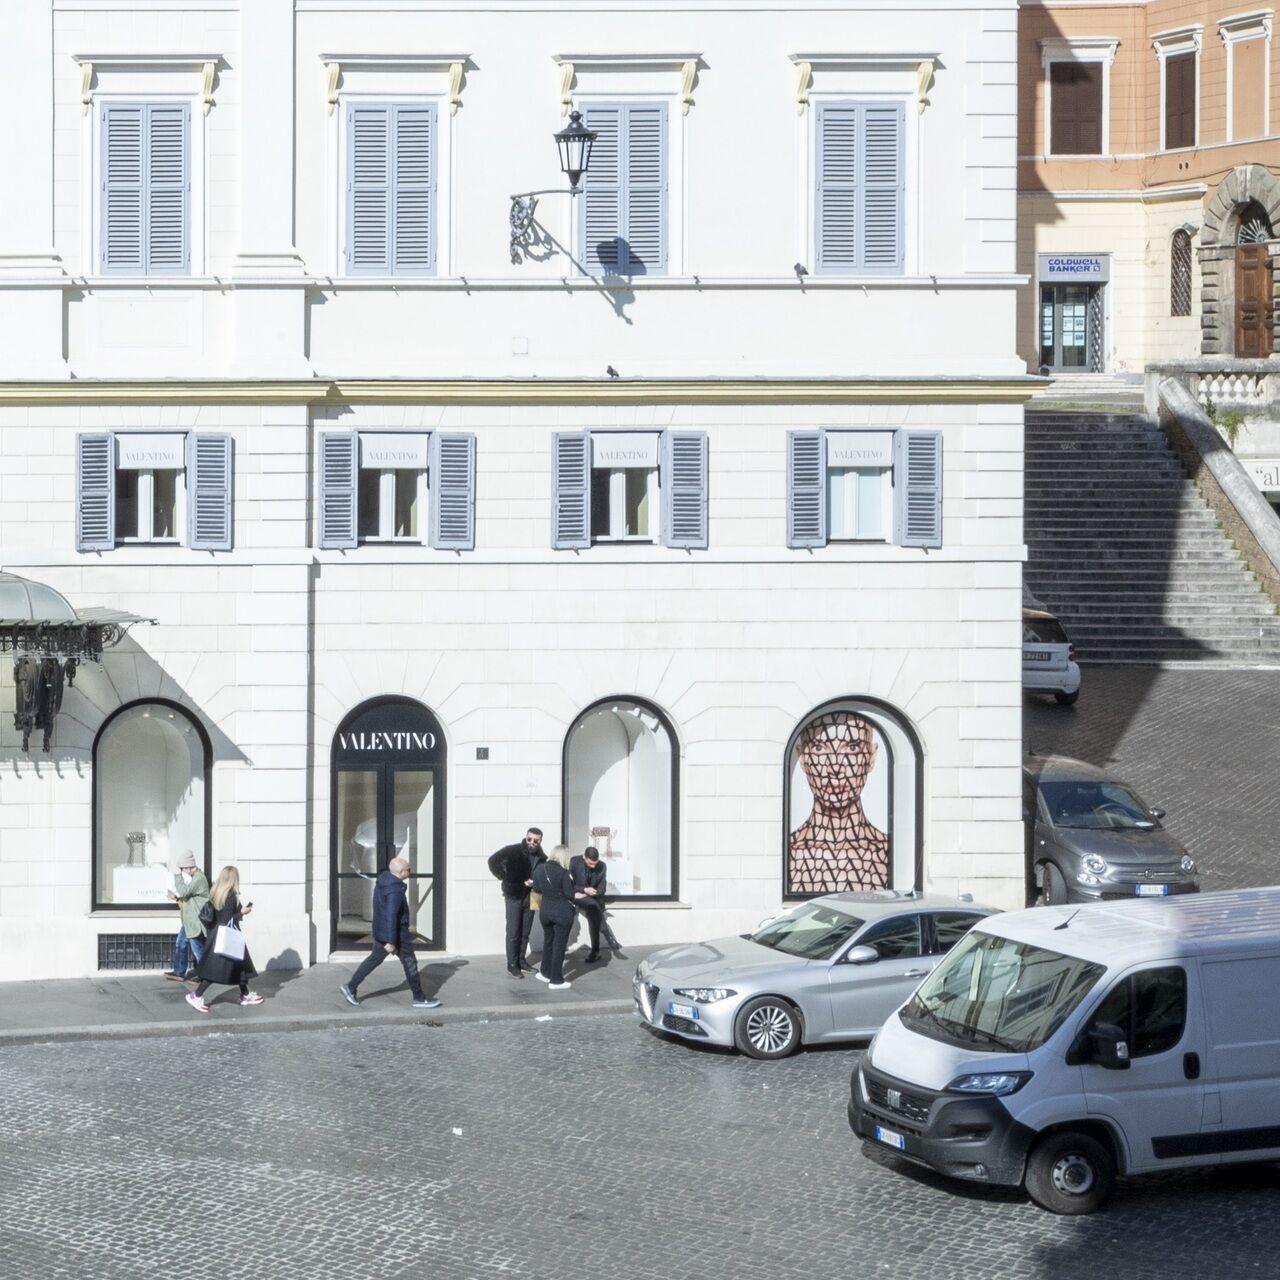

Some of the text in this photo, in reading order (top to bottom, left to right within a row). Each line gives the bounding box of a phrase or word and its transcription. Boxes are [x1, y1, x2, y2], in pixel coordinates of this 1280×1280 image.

[1048, 258, 1101, 266] COLDWELL
[1049, 265, 1090, 273] BANKER
[126, 452, 175, 461] VALENTINO
[369, 452, 418, 461] VALENTINO
[600, 451, 648, 460] VALENTINO
[834, 450, 883, 459] VALENTINO
[340, 732, 436, 750] VALENTINO
